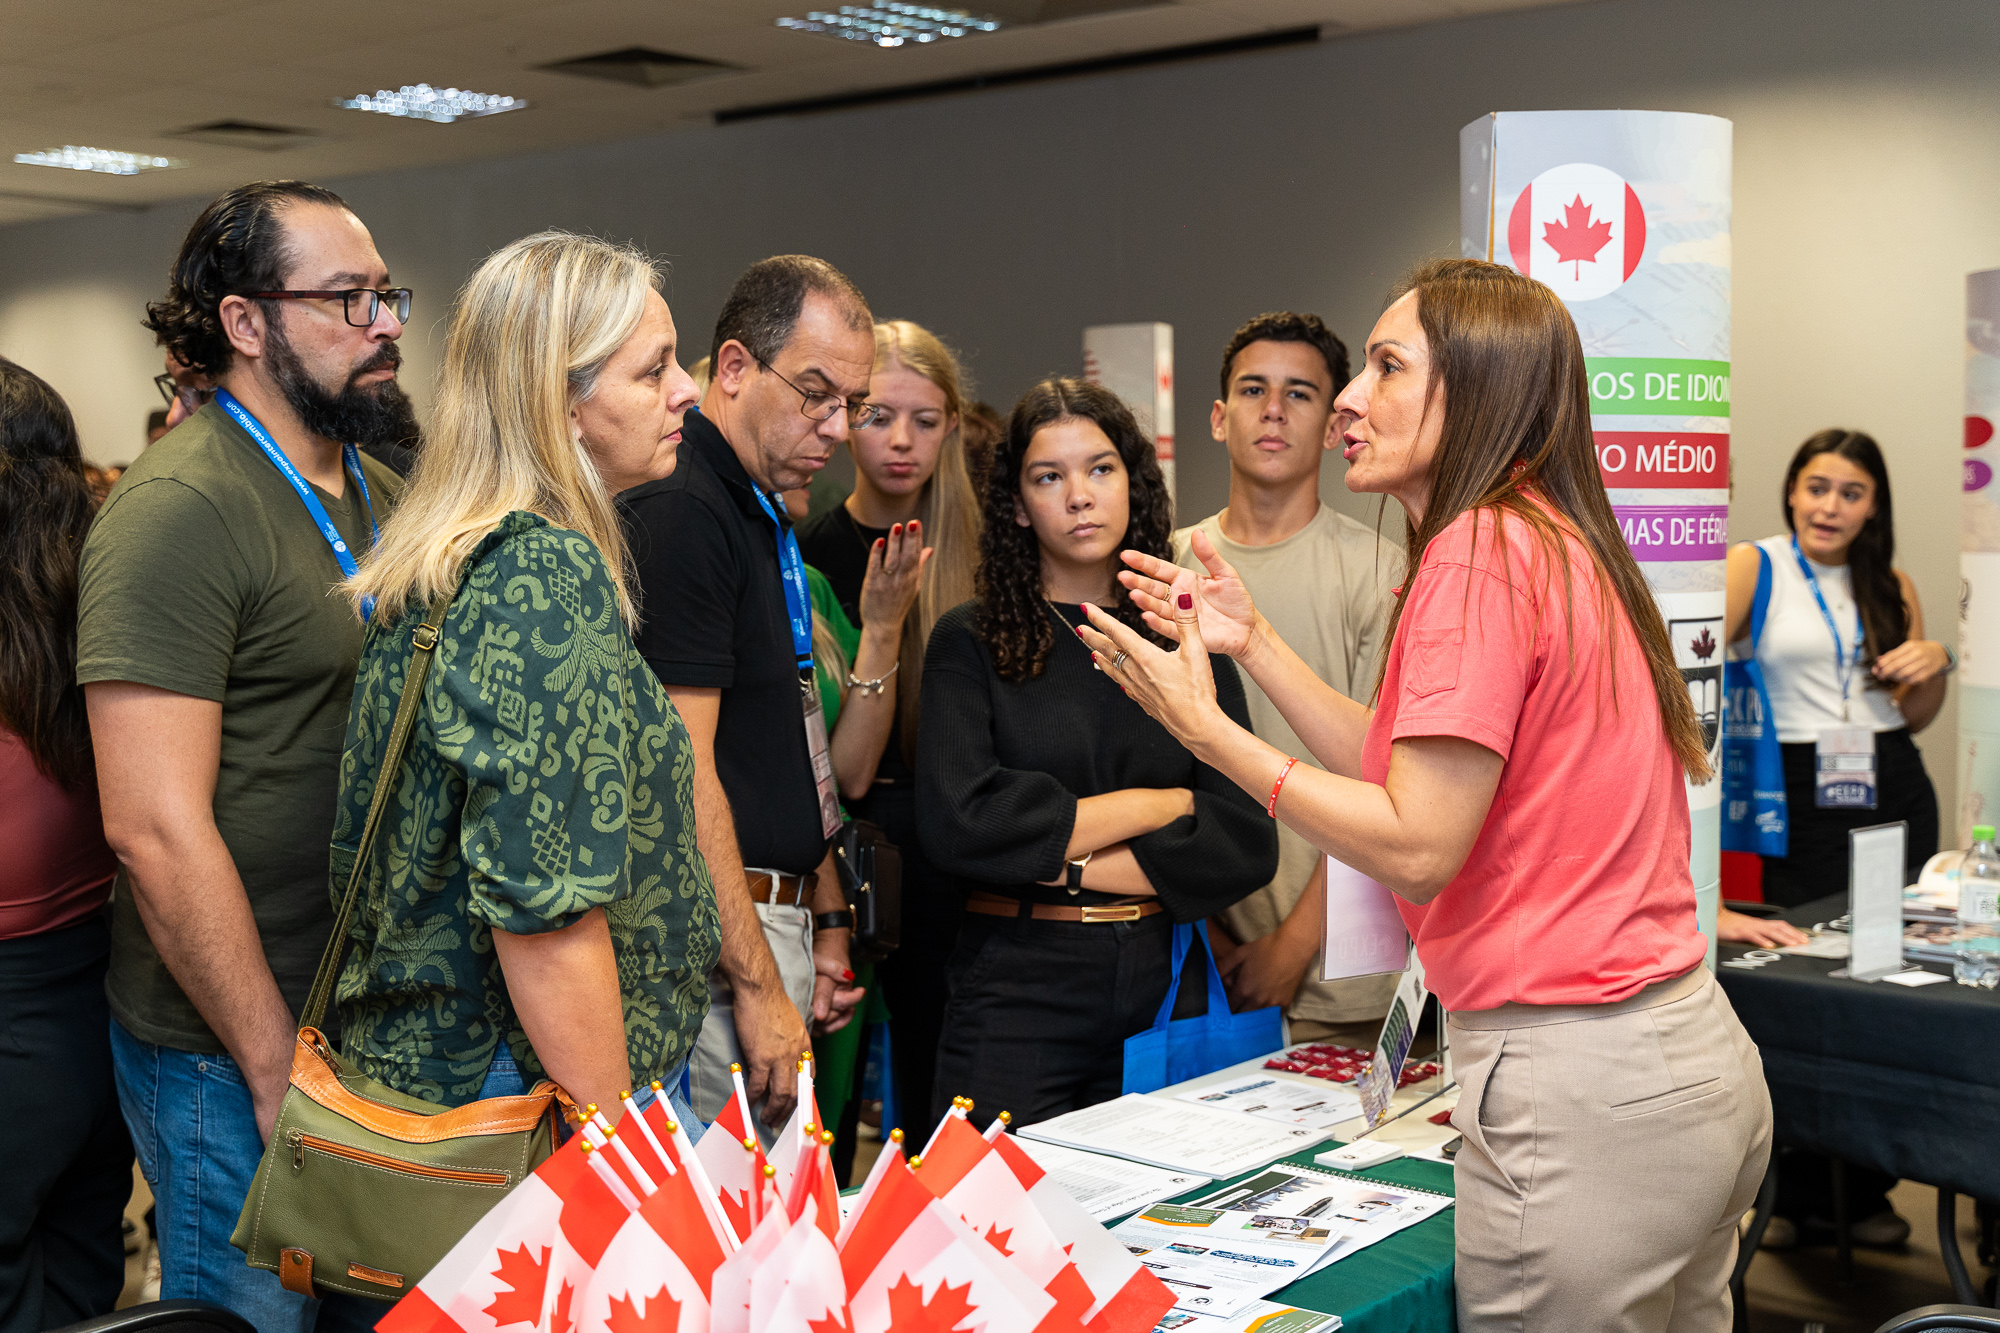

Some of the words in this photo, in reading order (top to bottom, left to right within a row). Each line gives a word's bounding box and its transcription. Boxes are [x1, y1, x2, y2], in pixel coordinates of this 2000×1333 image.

[1587, 372, 1635, 400] OS
[1644, 373, 1681, 401] DE
[226, 401, 310, 495] www.expointercambio.com
[1596, 444, 1627, 473] O
[1635, 440, 1717, 474] MÉDIO
[1670, 517, 1696, 546] DE
